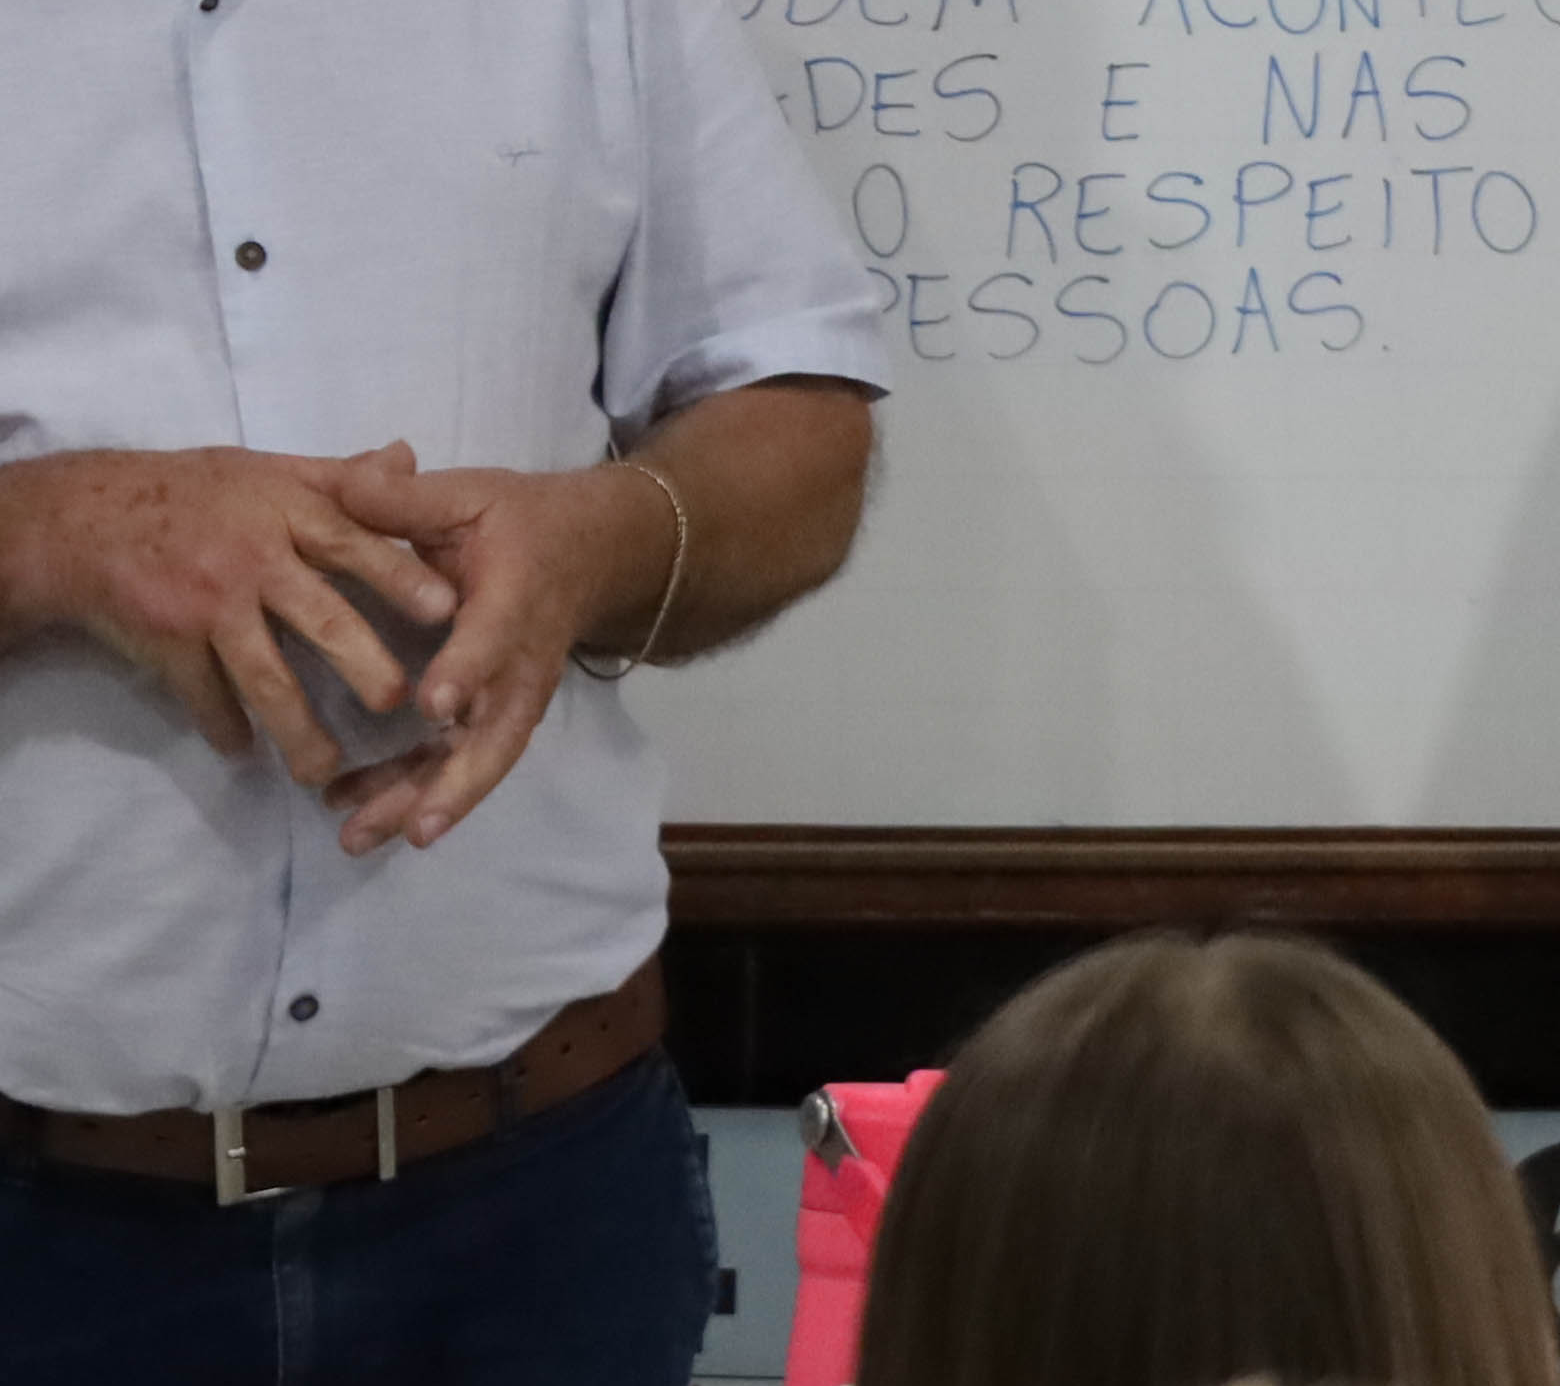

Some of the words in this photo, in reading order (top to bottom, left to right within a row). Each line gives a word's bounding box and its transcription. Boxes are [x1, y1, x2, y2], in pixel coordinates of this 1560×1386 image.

[1099, 60, 1151, 142] E
[1260, 50, 1473, 144] NAS
[851, 163, 908, 259] O
[1005, 162, 1537, 265] RESPEITO
